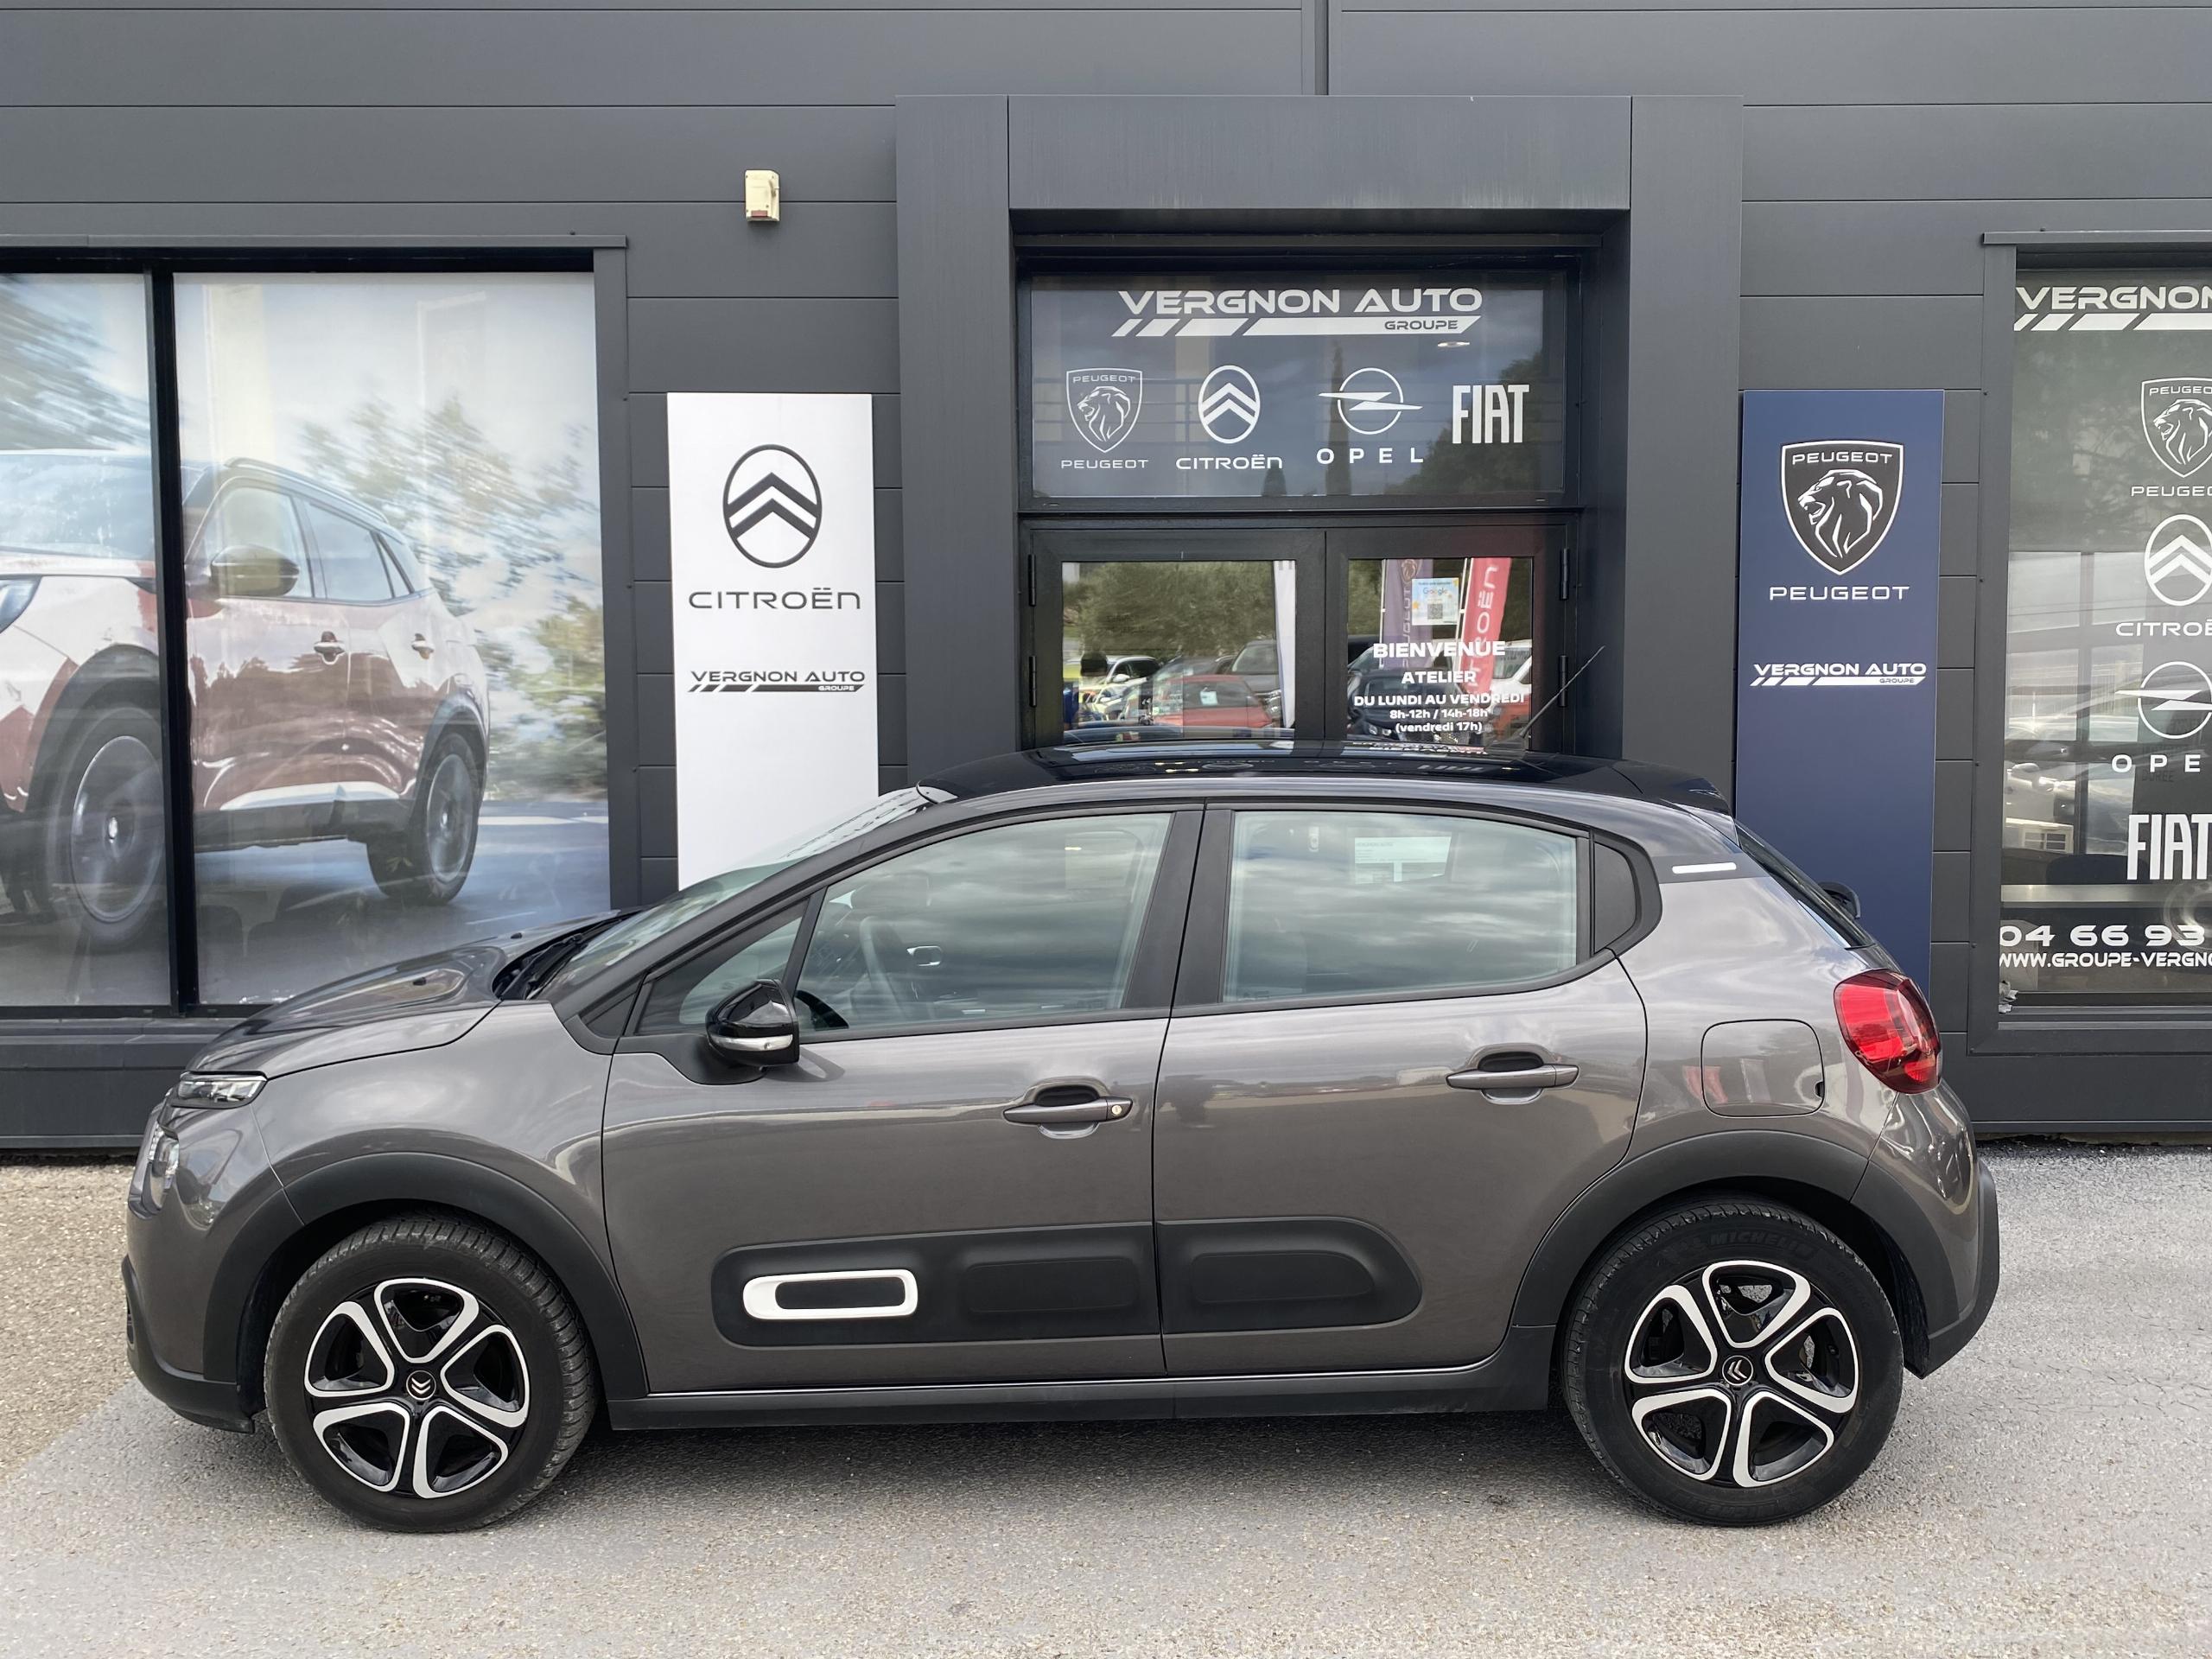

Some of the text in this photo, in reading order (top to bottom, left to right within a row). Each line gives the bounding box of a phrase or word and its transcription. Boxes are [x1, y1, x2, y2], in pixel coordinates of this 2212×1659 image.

[1118, 288, 1483, 314] VERGNON AUTO
[1384, 320, 1459, 330] GROUPE
[1072, 374, 1136, 384] PEUGEOT
[1452, 385, 1529, 443] FIAT
[1316, 447, 1424, 465] OPEL
[1792, 451, 1893, 465] PEUGEOT
[1061, 459, 1149, 469] PEUGEOT
[1770, 586, 1910, 601] PEUGEOT
[1373, 640, 1506, 658] BIENVENUE
[691, 671, 866, 683] VERGNON AUTO
[1753, 663, 1927, 677] VERGNON AUTO
[1401, 671, 1477, 684] ATELIER
[1353, 693, 1524, 707] DU LUNDI AU VENDREDI
[1389, 709, 1431, 720] 8h-12h
[1441, 709, 1488, 719] 14h-18h
[1395, 721, 1483, 734] (vendredi 17h)
[2126, 814, 2212, 880] FIAT
[1999, 925, 2205, 947] 04 66 93
